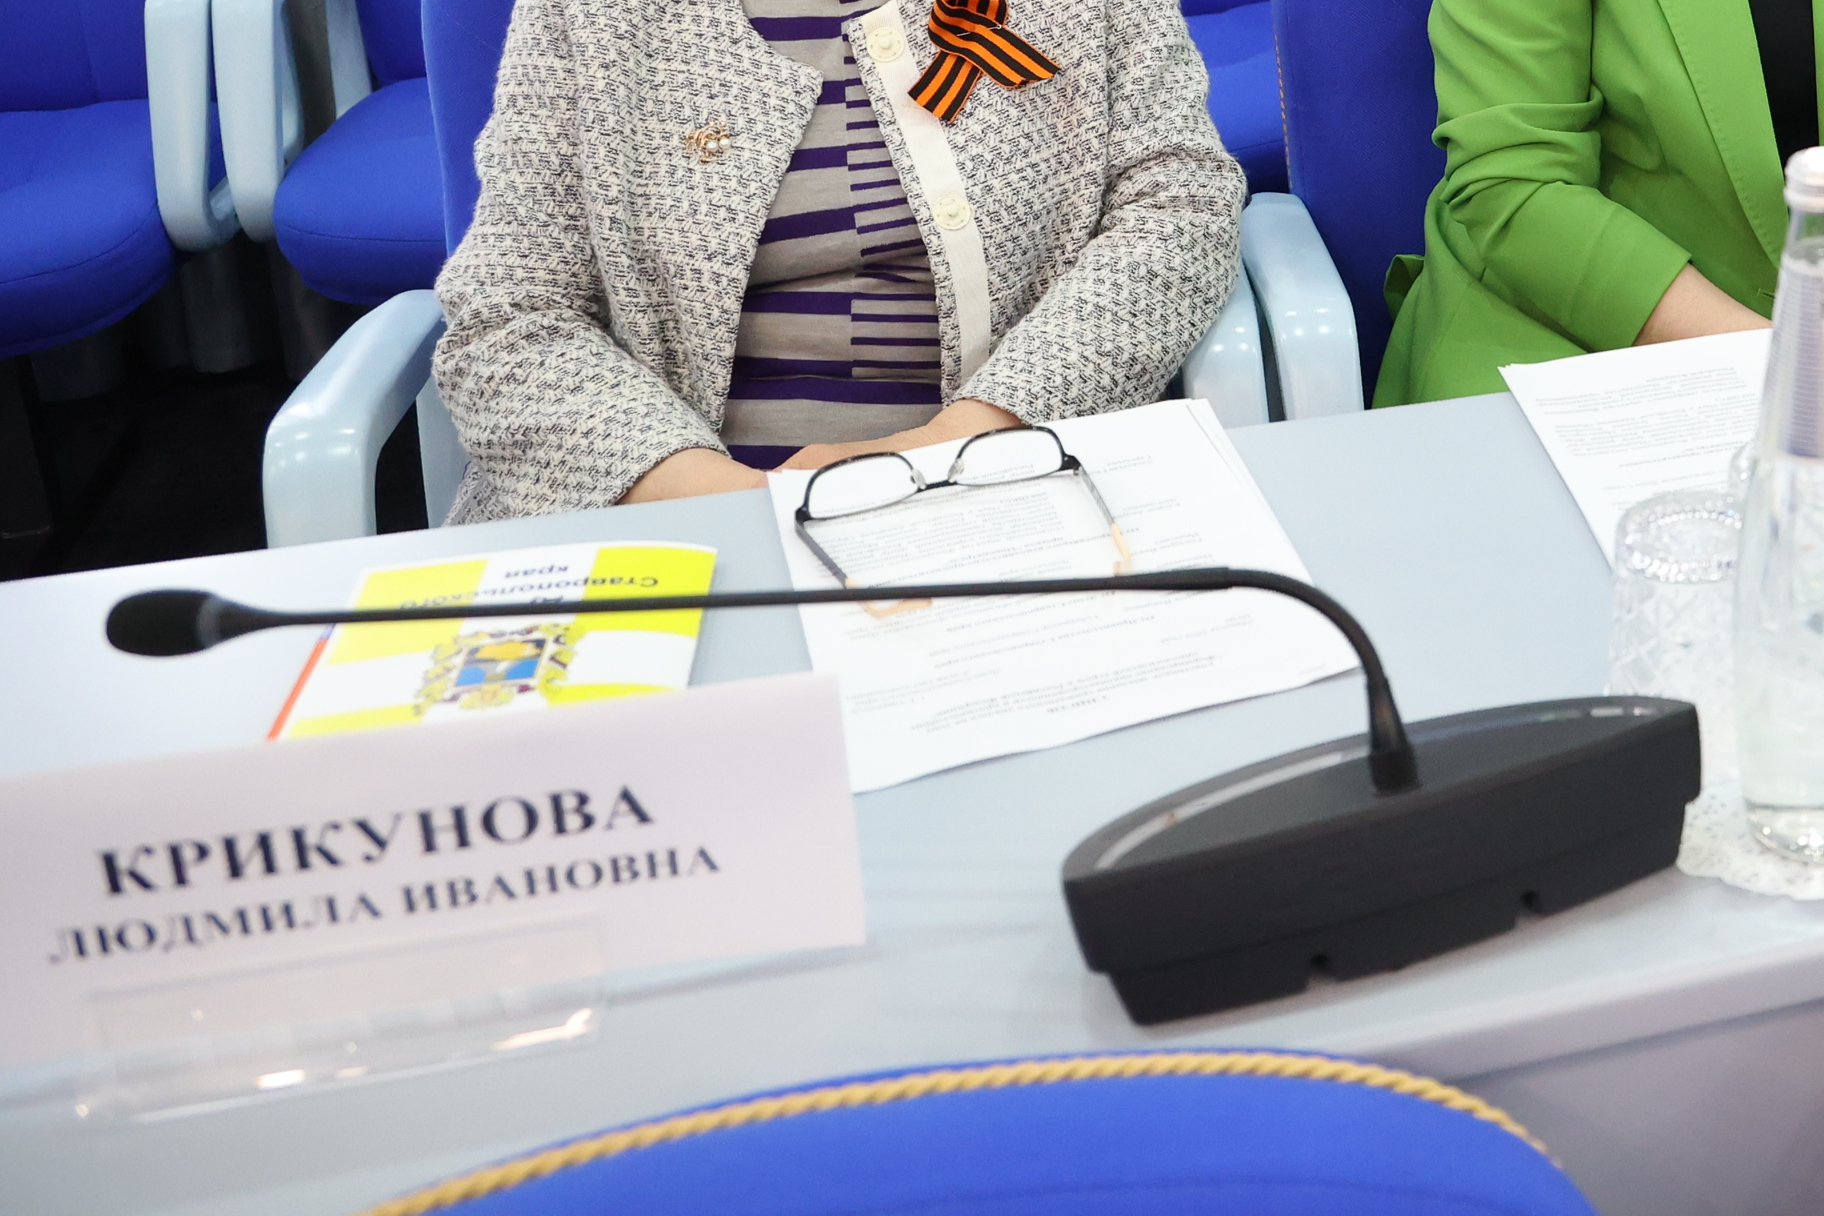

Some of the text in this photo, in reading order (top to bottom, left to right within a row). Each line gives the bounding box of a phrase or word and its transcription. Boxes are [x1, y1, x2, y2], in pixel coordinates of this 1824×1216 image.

[504, 564, 569, 578] края
[98, 784, 654, 896] КРИКУНОВА
[48, 846, 719, 964] ЛЮДМИЛА ИВАНОВНА
